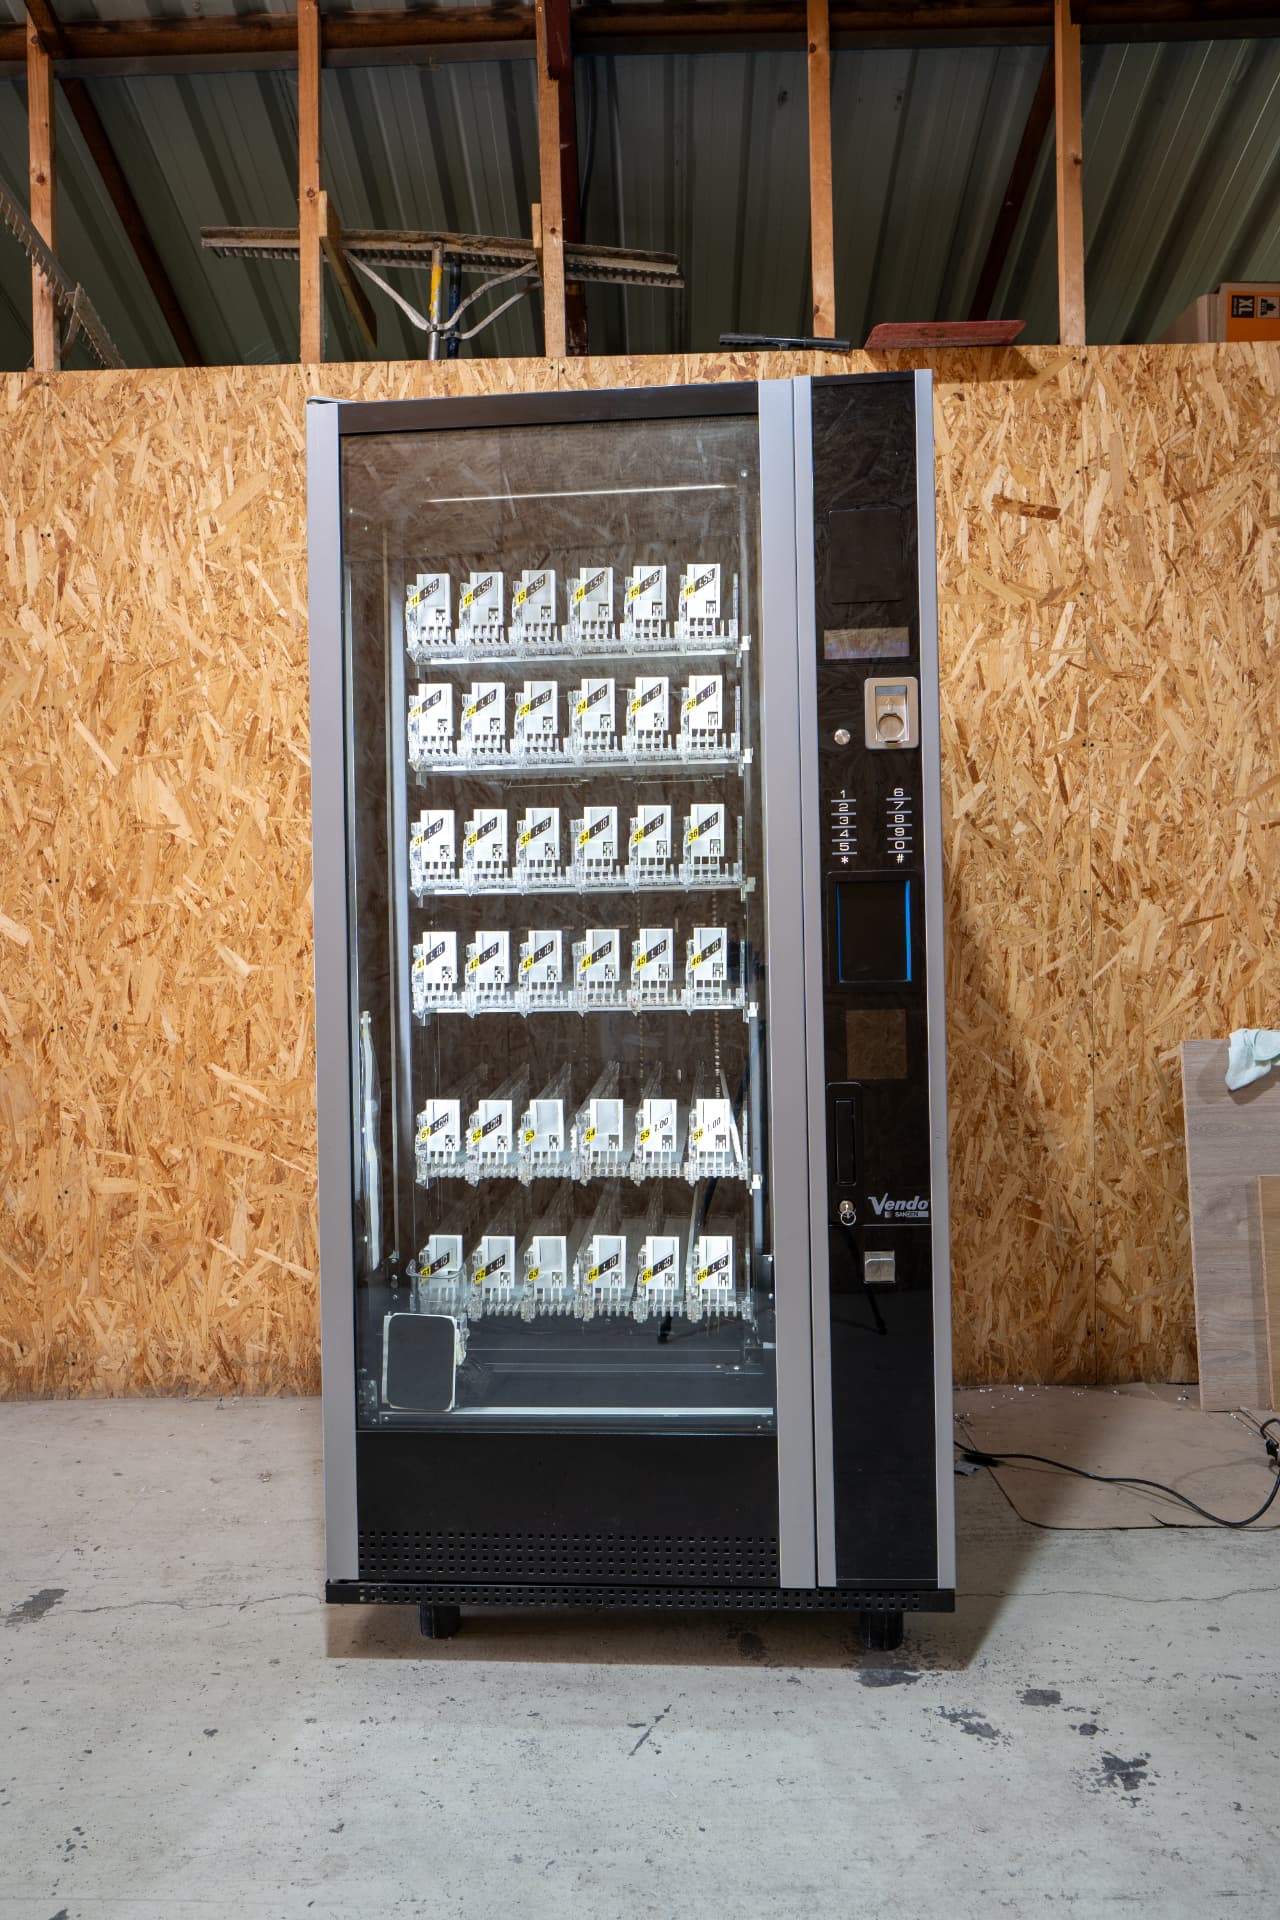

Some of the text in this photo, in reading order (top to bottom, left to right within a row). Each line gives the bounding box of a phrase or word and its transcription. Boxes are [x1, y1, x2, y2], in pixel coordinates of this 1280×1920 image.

[685, 587, 693, 595] 16
[411, 597, 418, 605] 11
[464, 596, 472, 604] 12
[467, 707, 475, 716] 22
[578, 702, 586, 713] 24
[839, 804, 849, 812] 2
[894, 802, 904, 810] 7
[895, 815, 904, 823] 8
[634, 831, 643, 842] 35
[689, 830, 697, 840] 36
[840, 830, 849, 838] 4
[895, 828, 904, 836] 9
[415, 837, 422, 845] 31
[467, 835, 476, 845] 32
[580, 833, 588, 844] 34
[840, 843, 849, 851] 5
[897, 854, 904, 863] #
[470, 960, 478, 969] 42
[524, 959, 532, 968] 43
[582, 956, 591, 966] 44
[637, 956, 646, 965] 45
[692, 955, 701, 965] 46
[421, 1129, 430, 1137] 51
[641, 1118, 669, 1140] 55 1.00
[693, 1117, 721, 1140] 56 1.00
[473, 1130, 481, 1140] 52
[526, 1131, 534, 1141] 53
[586, 1130, 595, 1139] 54
[868, 1193, 928, 1215] Vendo
[476, 1271, 485, 1280] 62
[529, 1270, 537, 1279] 63
[698, 1272, 707, 1281] 66
